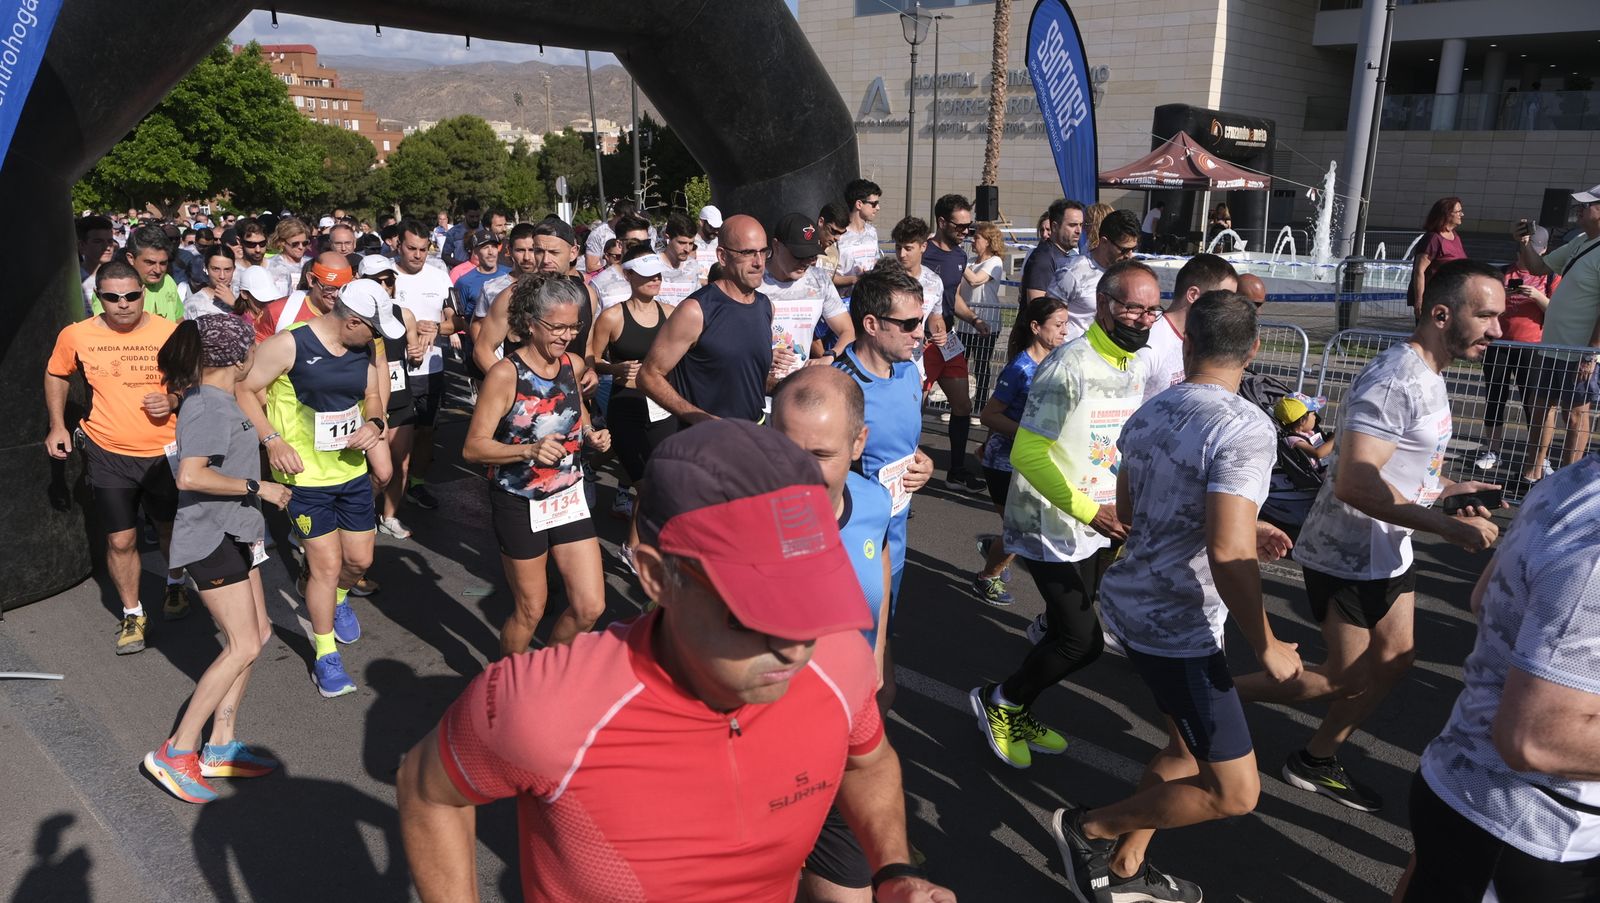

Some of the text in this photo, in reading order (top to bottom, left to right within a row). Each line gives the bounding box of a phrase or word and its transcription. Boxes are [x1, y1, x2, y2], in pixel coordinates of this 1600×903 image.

[329, 419, 356, 438] 112
[538, 491, 580, 514] 1134
[768, 780, 833, 812] SURAL
